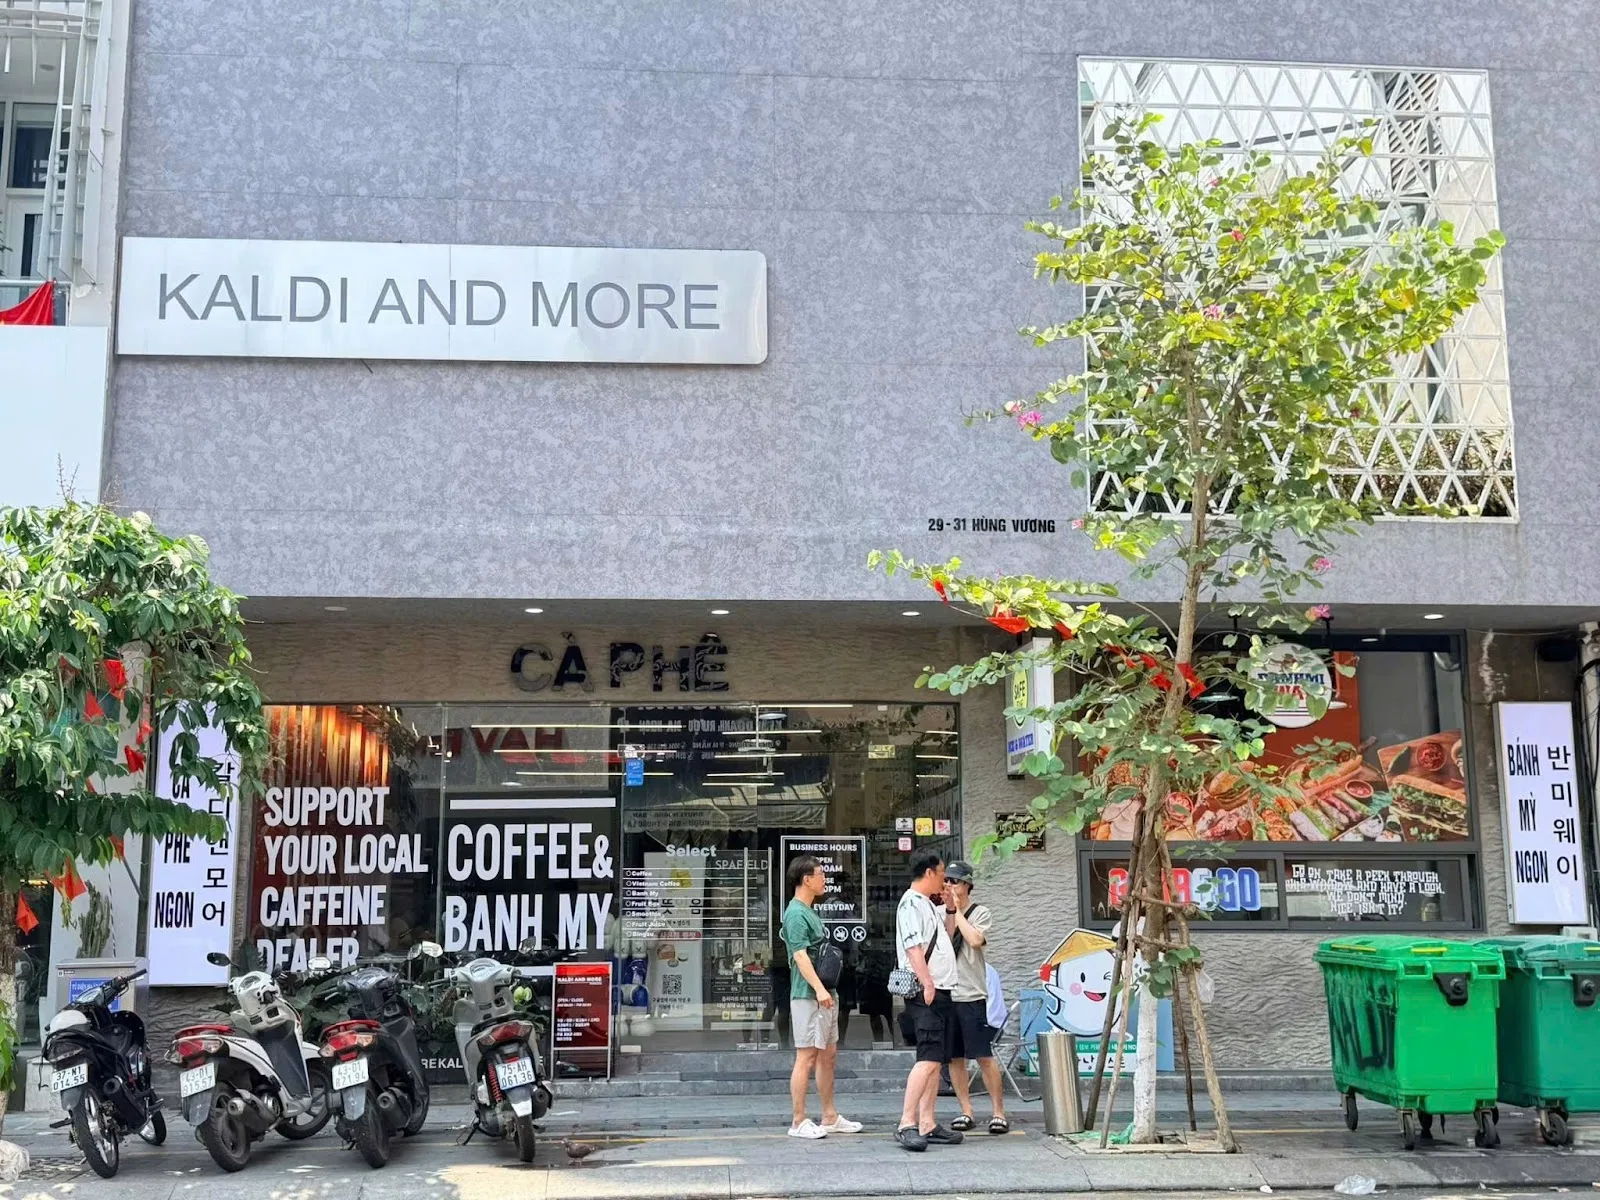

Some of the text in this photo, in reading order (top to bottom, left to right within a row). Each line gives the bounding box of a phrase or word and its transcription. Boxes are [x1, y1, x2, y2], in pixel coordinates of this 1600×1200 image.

[158, 272, 720, 331] KALDI AND MORE
[971, 515, 1006, 532] HÙNG
[1011, 518, 1056, 533] VƯƠNG
[609, 632, 730, 692] PHÊ
[1507, 737, 1540, 776] BÁNH
[263, 787, 390, 827] SUPPORT
[1547, 746, 1578, 881] 반미웨이
[264, 833, 429, 875] YOUR LOCAL
[665, 844, 717, 857] Select
[715, 860, 768, 870] SPAFELD
[829, 844, 857, 852] HOURS
[1292, 865, 1305, 878] GO
[1326, 870, 1353, 880] TAKE
[1355, 869, 1363, 880] A
[1365, 869, 1390, 882] PEEK
[1393, 871, 1439, 883] THROUGH
[1515, 850, 1549, 883] NGON
[1326, 891, 1343, 901] WE
[1357, 881, 1377, 892] AND
[1380, 882, 1406, 893] HAVE
[1409, 883, 1417, 893] A
[154, 891, 194, 929] NGON
[260, 885, 387, 928] CAFFEINE
[444, 893, 613, 952] BANH MY
[632, 920, 647, 928] Fruit
[257, 937, 360, 975] DEALER
[53, 1074, 85, 1090] 014.55
